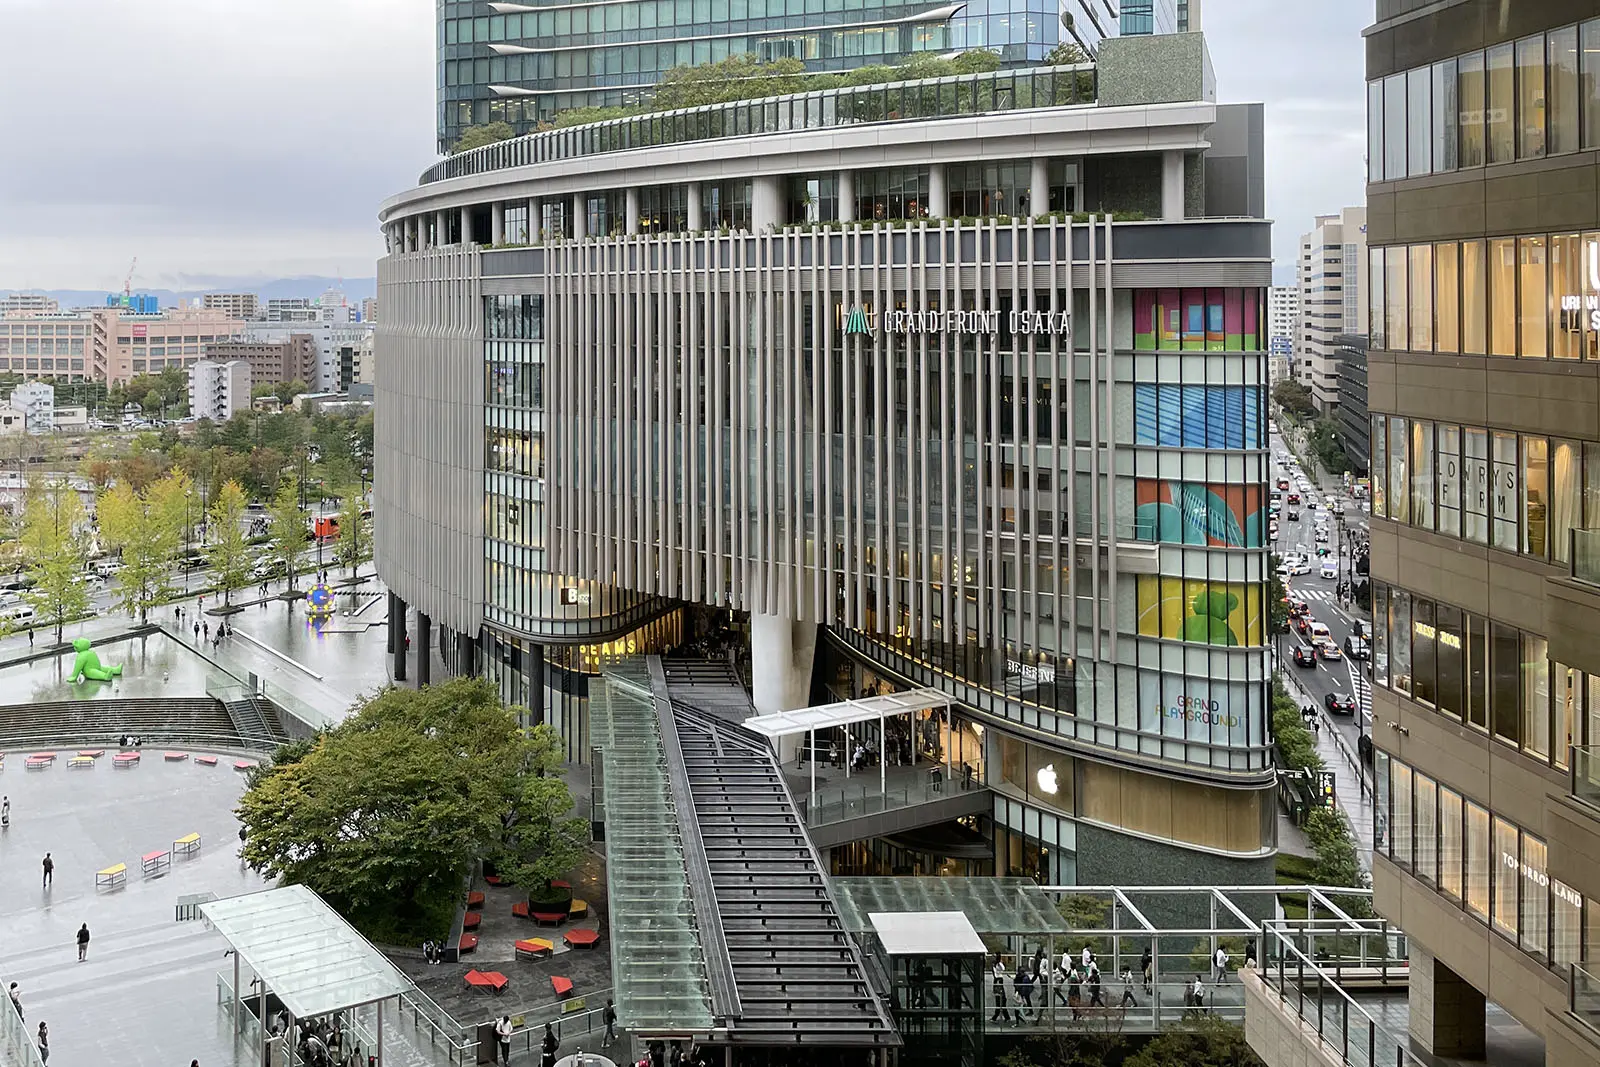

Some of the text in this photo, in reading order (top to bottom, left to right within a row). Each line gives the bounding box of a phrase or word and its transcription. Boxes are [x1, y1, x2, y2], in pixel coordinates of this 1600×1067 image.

[884, 310, 1070, 334] GRAND FRONT OSAKA
[1438, 461, 1514, 489] OWRYS
[1442, 484, 1506, 514] FRM
[1177, 695, 1219, 712] GRAND
